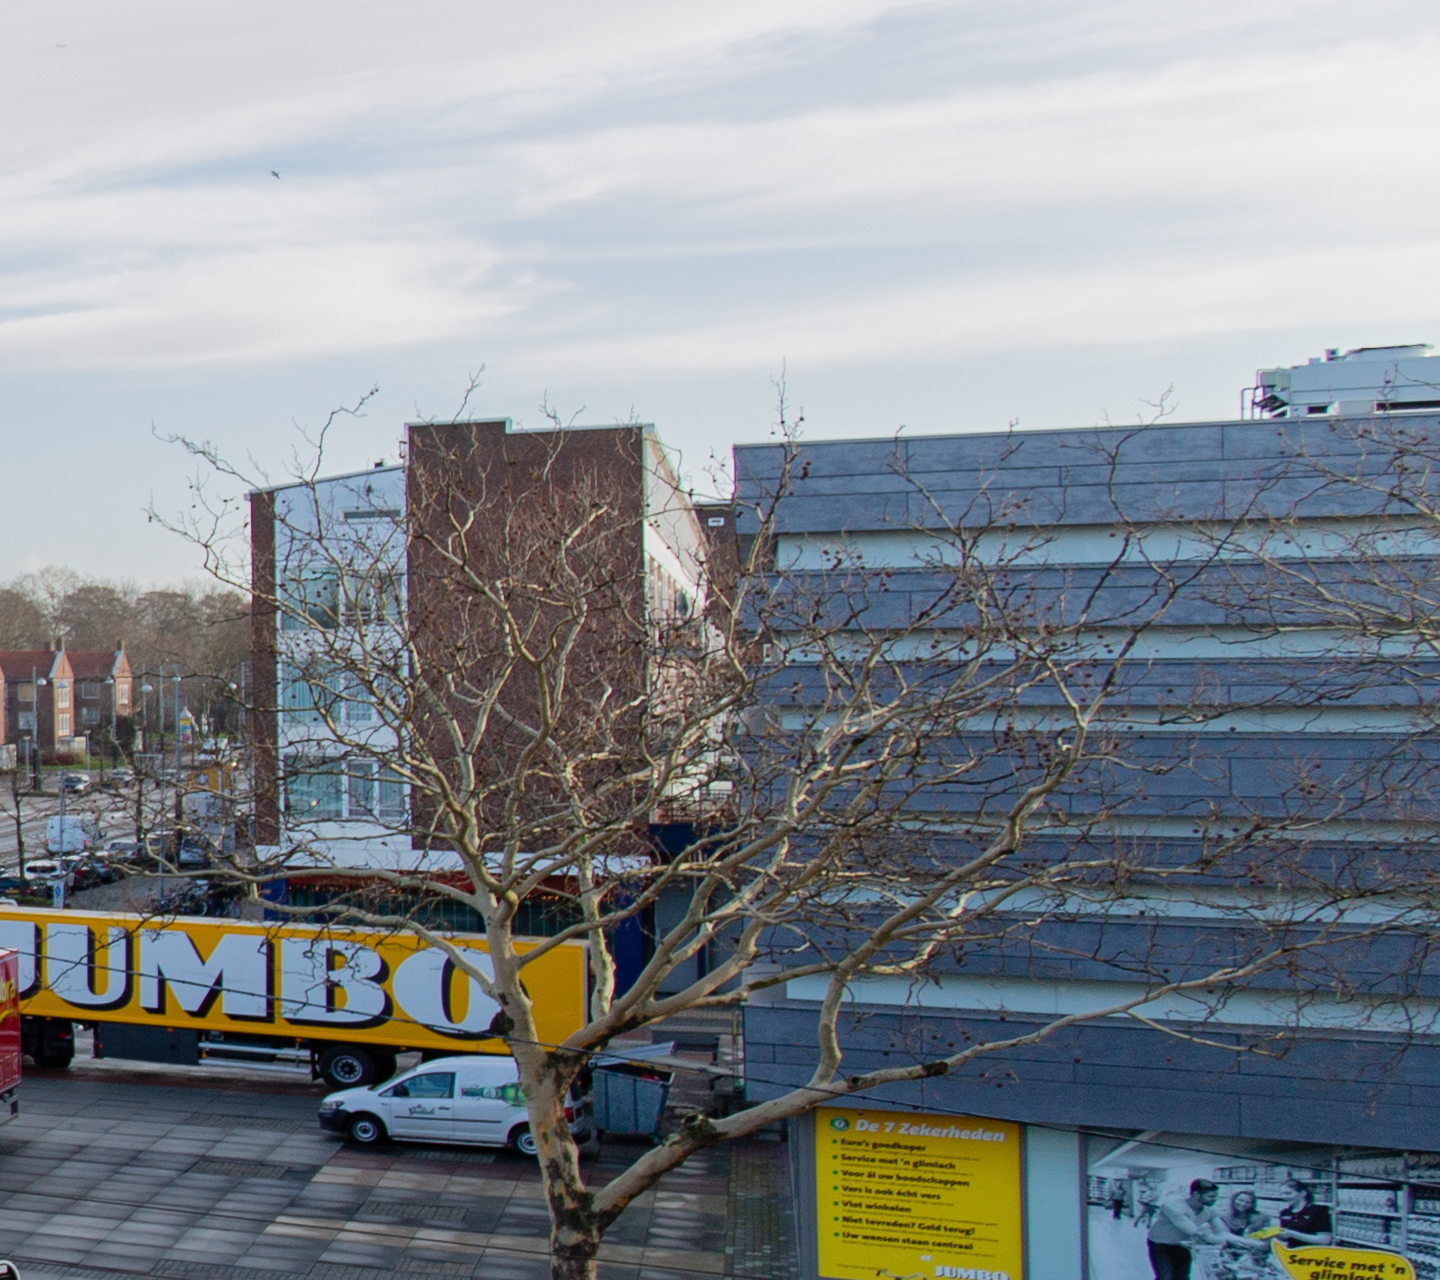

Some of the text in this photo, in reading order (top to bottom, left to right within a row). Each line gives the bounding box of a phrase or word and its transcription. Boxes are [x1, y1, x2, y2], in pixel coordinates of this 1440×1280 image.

[854, 1118, 1006, 1142] De 7 Zekerheden
[871, 1141, 926, 1152] goedkoper
[840, 1153, 876, 1163] Service
[879, 1157, 898, 1165] met
[912, 1160, 956, 1170] glimlach
[841, 1169, 864, 1177] Voor
[896, 1172, 970, 1187] boodschappen
[841, 1185, 862, 1193] Vers
[865, 1186, 873, 1194] is
[876, 1187, 894, 1196] ook
[920, 1191, 941, 1200] vers
[841, 1200, 912, 1213] Vlot winkelen
[842, 1216, 975, 1236] Niet tevreden? Geld terug!
[842, 1231, 973, 1250] Uw wensen staan centraal
[1288, 1254, 1346, 1269] Service
[1350, 1260, 1385, 1273] met
